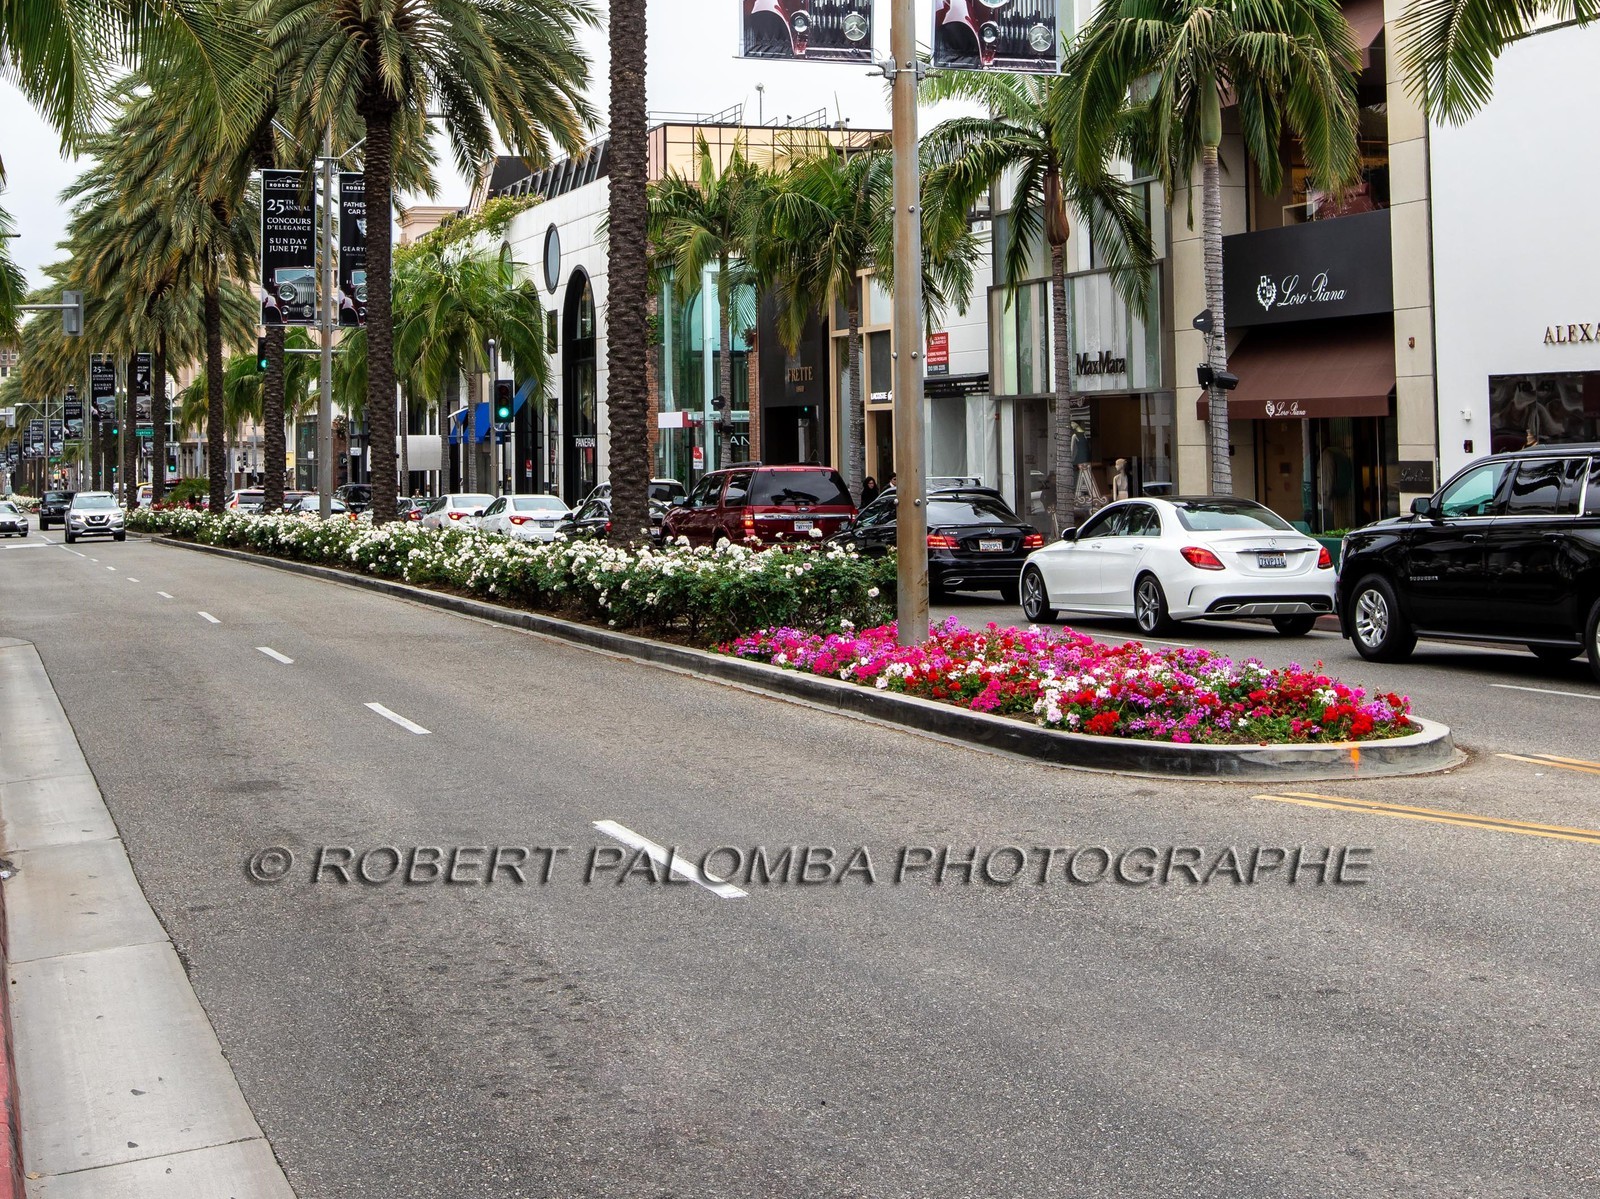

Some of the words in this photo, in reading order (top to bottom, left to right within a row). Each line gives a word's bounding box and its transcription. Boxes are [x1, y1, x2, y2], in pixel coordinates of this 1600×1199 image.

[267, 217, 311, 225] CONCOURS
[1277, 274, 1308, 307] Loro
[1309, 268, 1348, 303] Piana
[787, 366, 813, 382] FRETTE
